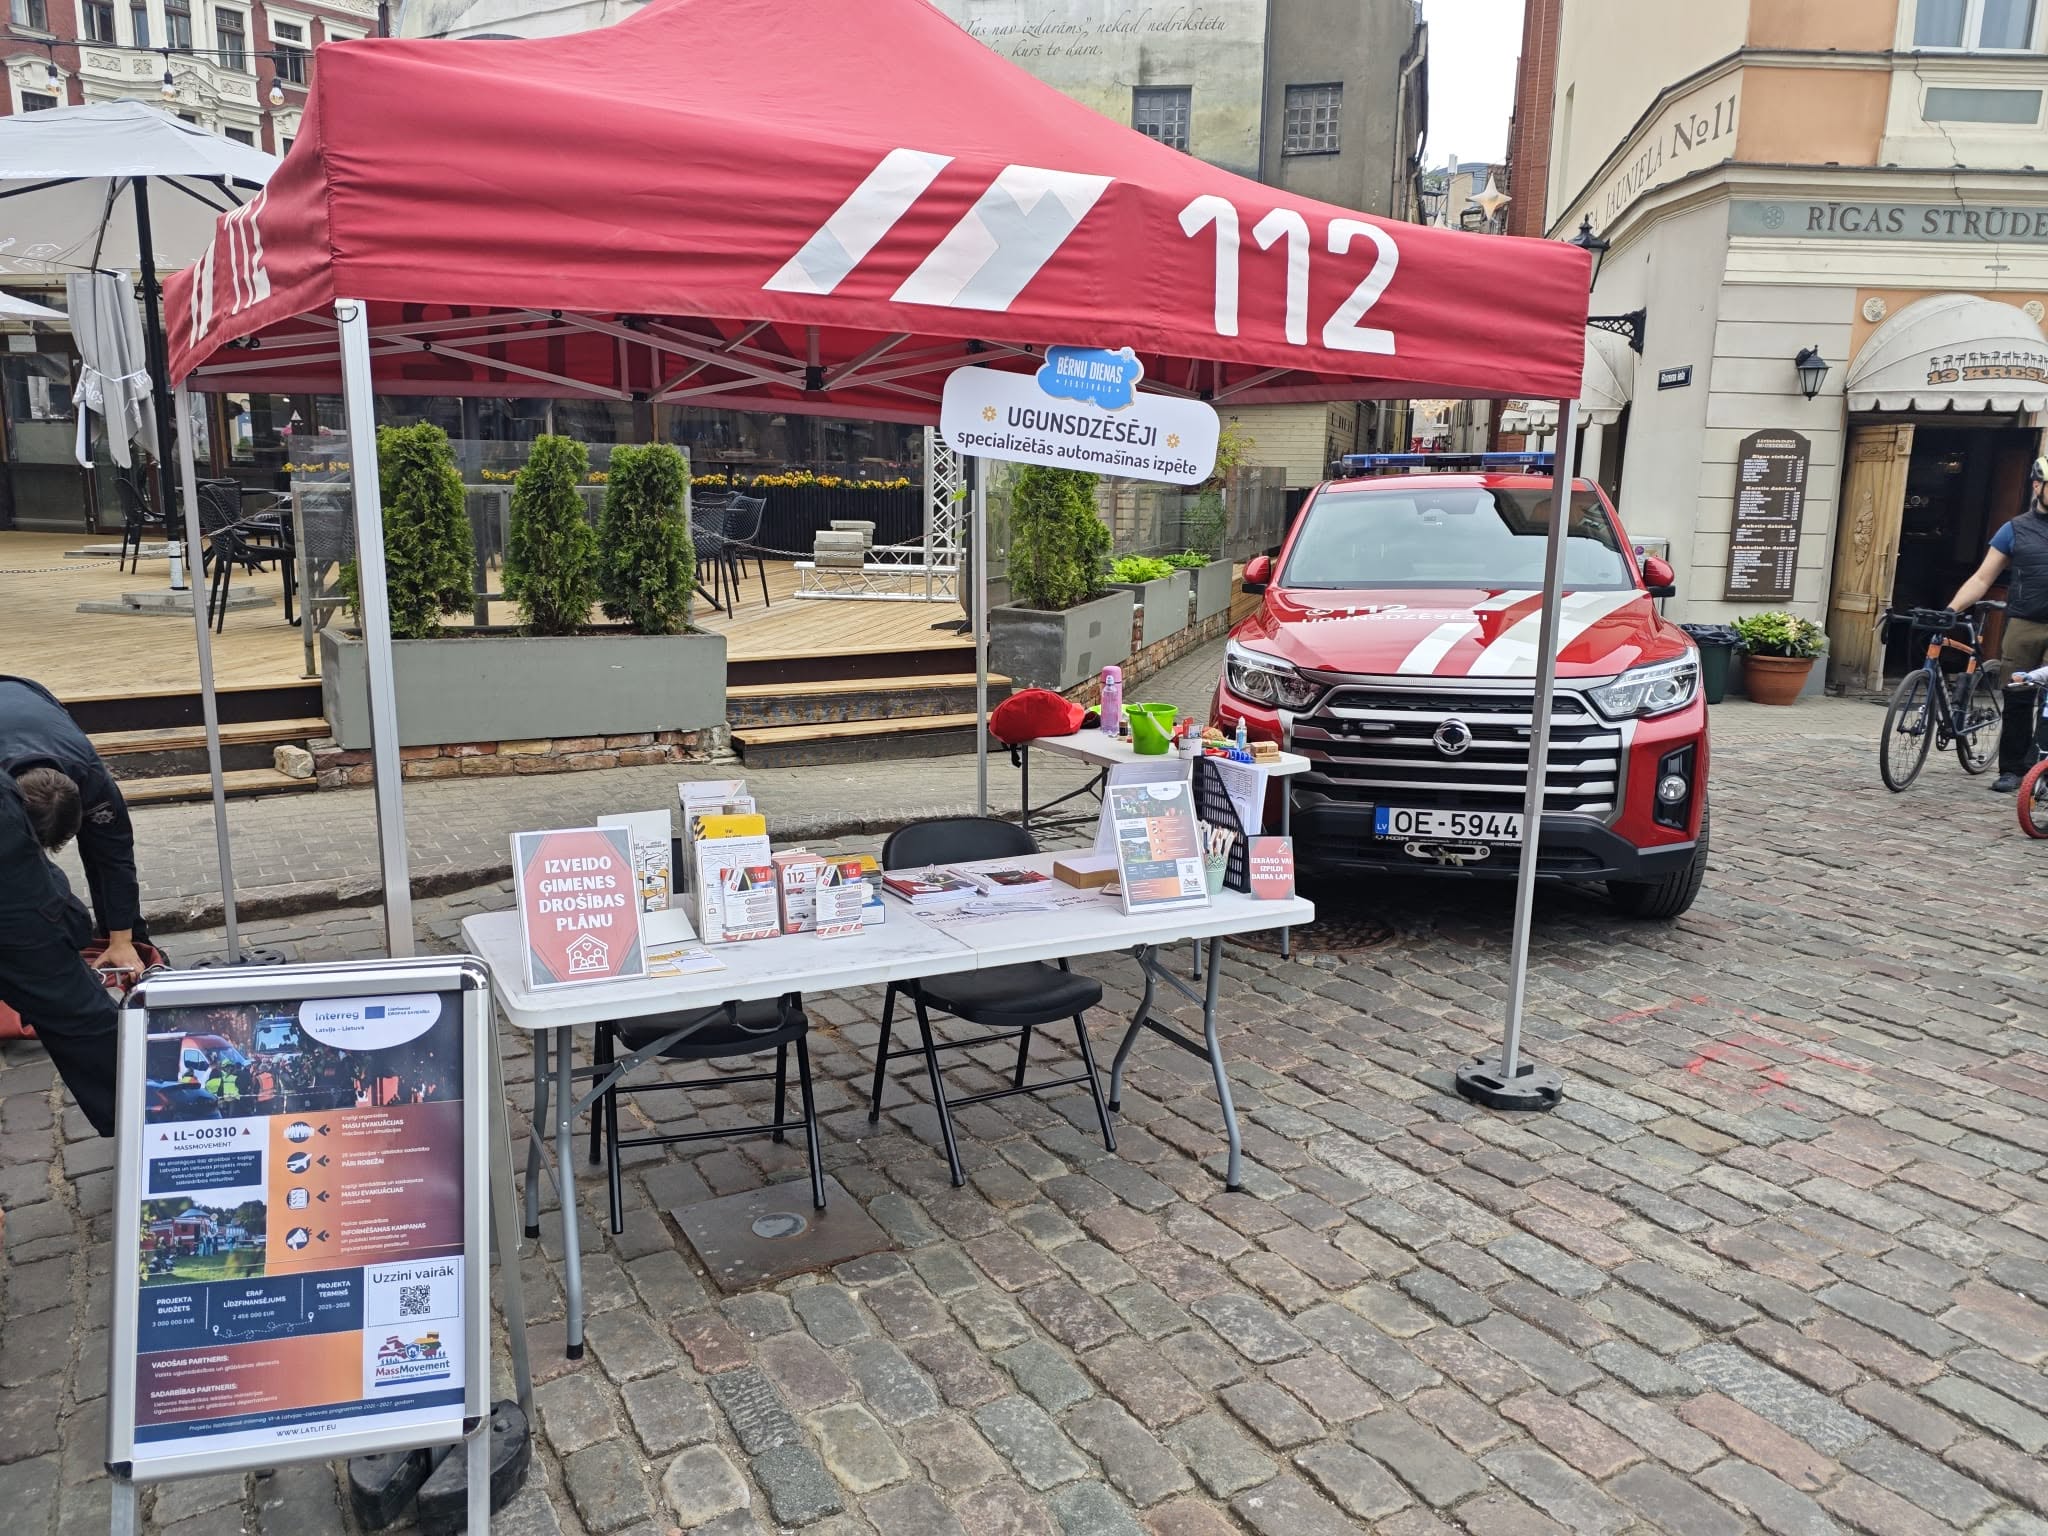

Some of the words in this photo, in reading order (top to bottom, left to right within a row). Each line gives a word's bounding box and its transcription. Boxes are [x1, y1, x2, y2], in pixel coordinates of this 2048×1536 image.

[1806, 202, 1906, 233] RĪGAS
[1177, 194, 1400, 355] 112
[1056, 355, 1088, 379] BĒRNU
[1089, 361, 1124, 384] DIENAS
[1927, 367, 1960, 385] 13
[1007, 405, 1157, 447] UGUNSDZĒSĒJI
[957, 431, 1054, 456] specializētās
[1056, 446, 1150, 470] automašīnas
[1153, 456, 1198, 477] izpēte
[1345, 604, 1408, 615] 112
[1376, 823, 1388, 831] LV
[1394, 811, 1519, 839] OE-5944
[544, 855, 612, 874] IZVEIDO
[787, 872, 806, 884] 112
[539, 875, 616, 898] ĢIMENES
[538, 893, 625, 914] DROŠĪBAS
[556, 913, 613, 932] PLĀNU
[341, 1121, 361, 1130] MASU
[361, 1119, 405, 1129] EVAKUĀCIJAS
[174, 1126, 237, 1141] LL-00310
[174, 1141, 232, 1151] MASSMOVEMENT
[341, 1190, 360, 1198] MASU
[360, 1186, 405, 1197] EVAKUĀCIJAS
[373, 1269, 412, 1284] Uzzini
[415, 1265, 455, 1279] vairāk
[316, 1279, 351, 1290] PROJEKTA
[156, 1295, 193, 1306] PROJEKTA
[245, 1289, 264, 1298] ERAF
[223, 1294, 287, 1309] LĪDZFINANSĒJUMS
[157, 1305, 191, 1315] BUDŽETS
[151, 1358, 188, 1369] VADOŠAIS
[375, 1359, 450, 1377] MassMovement
[150, 1387, 196, 1399] SADARBĪBAS
